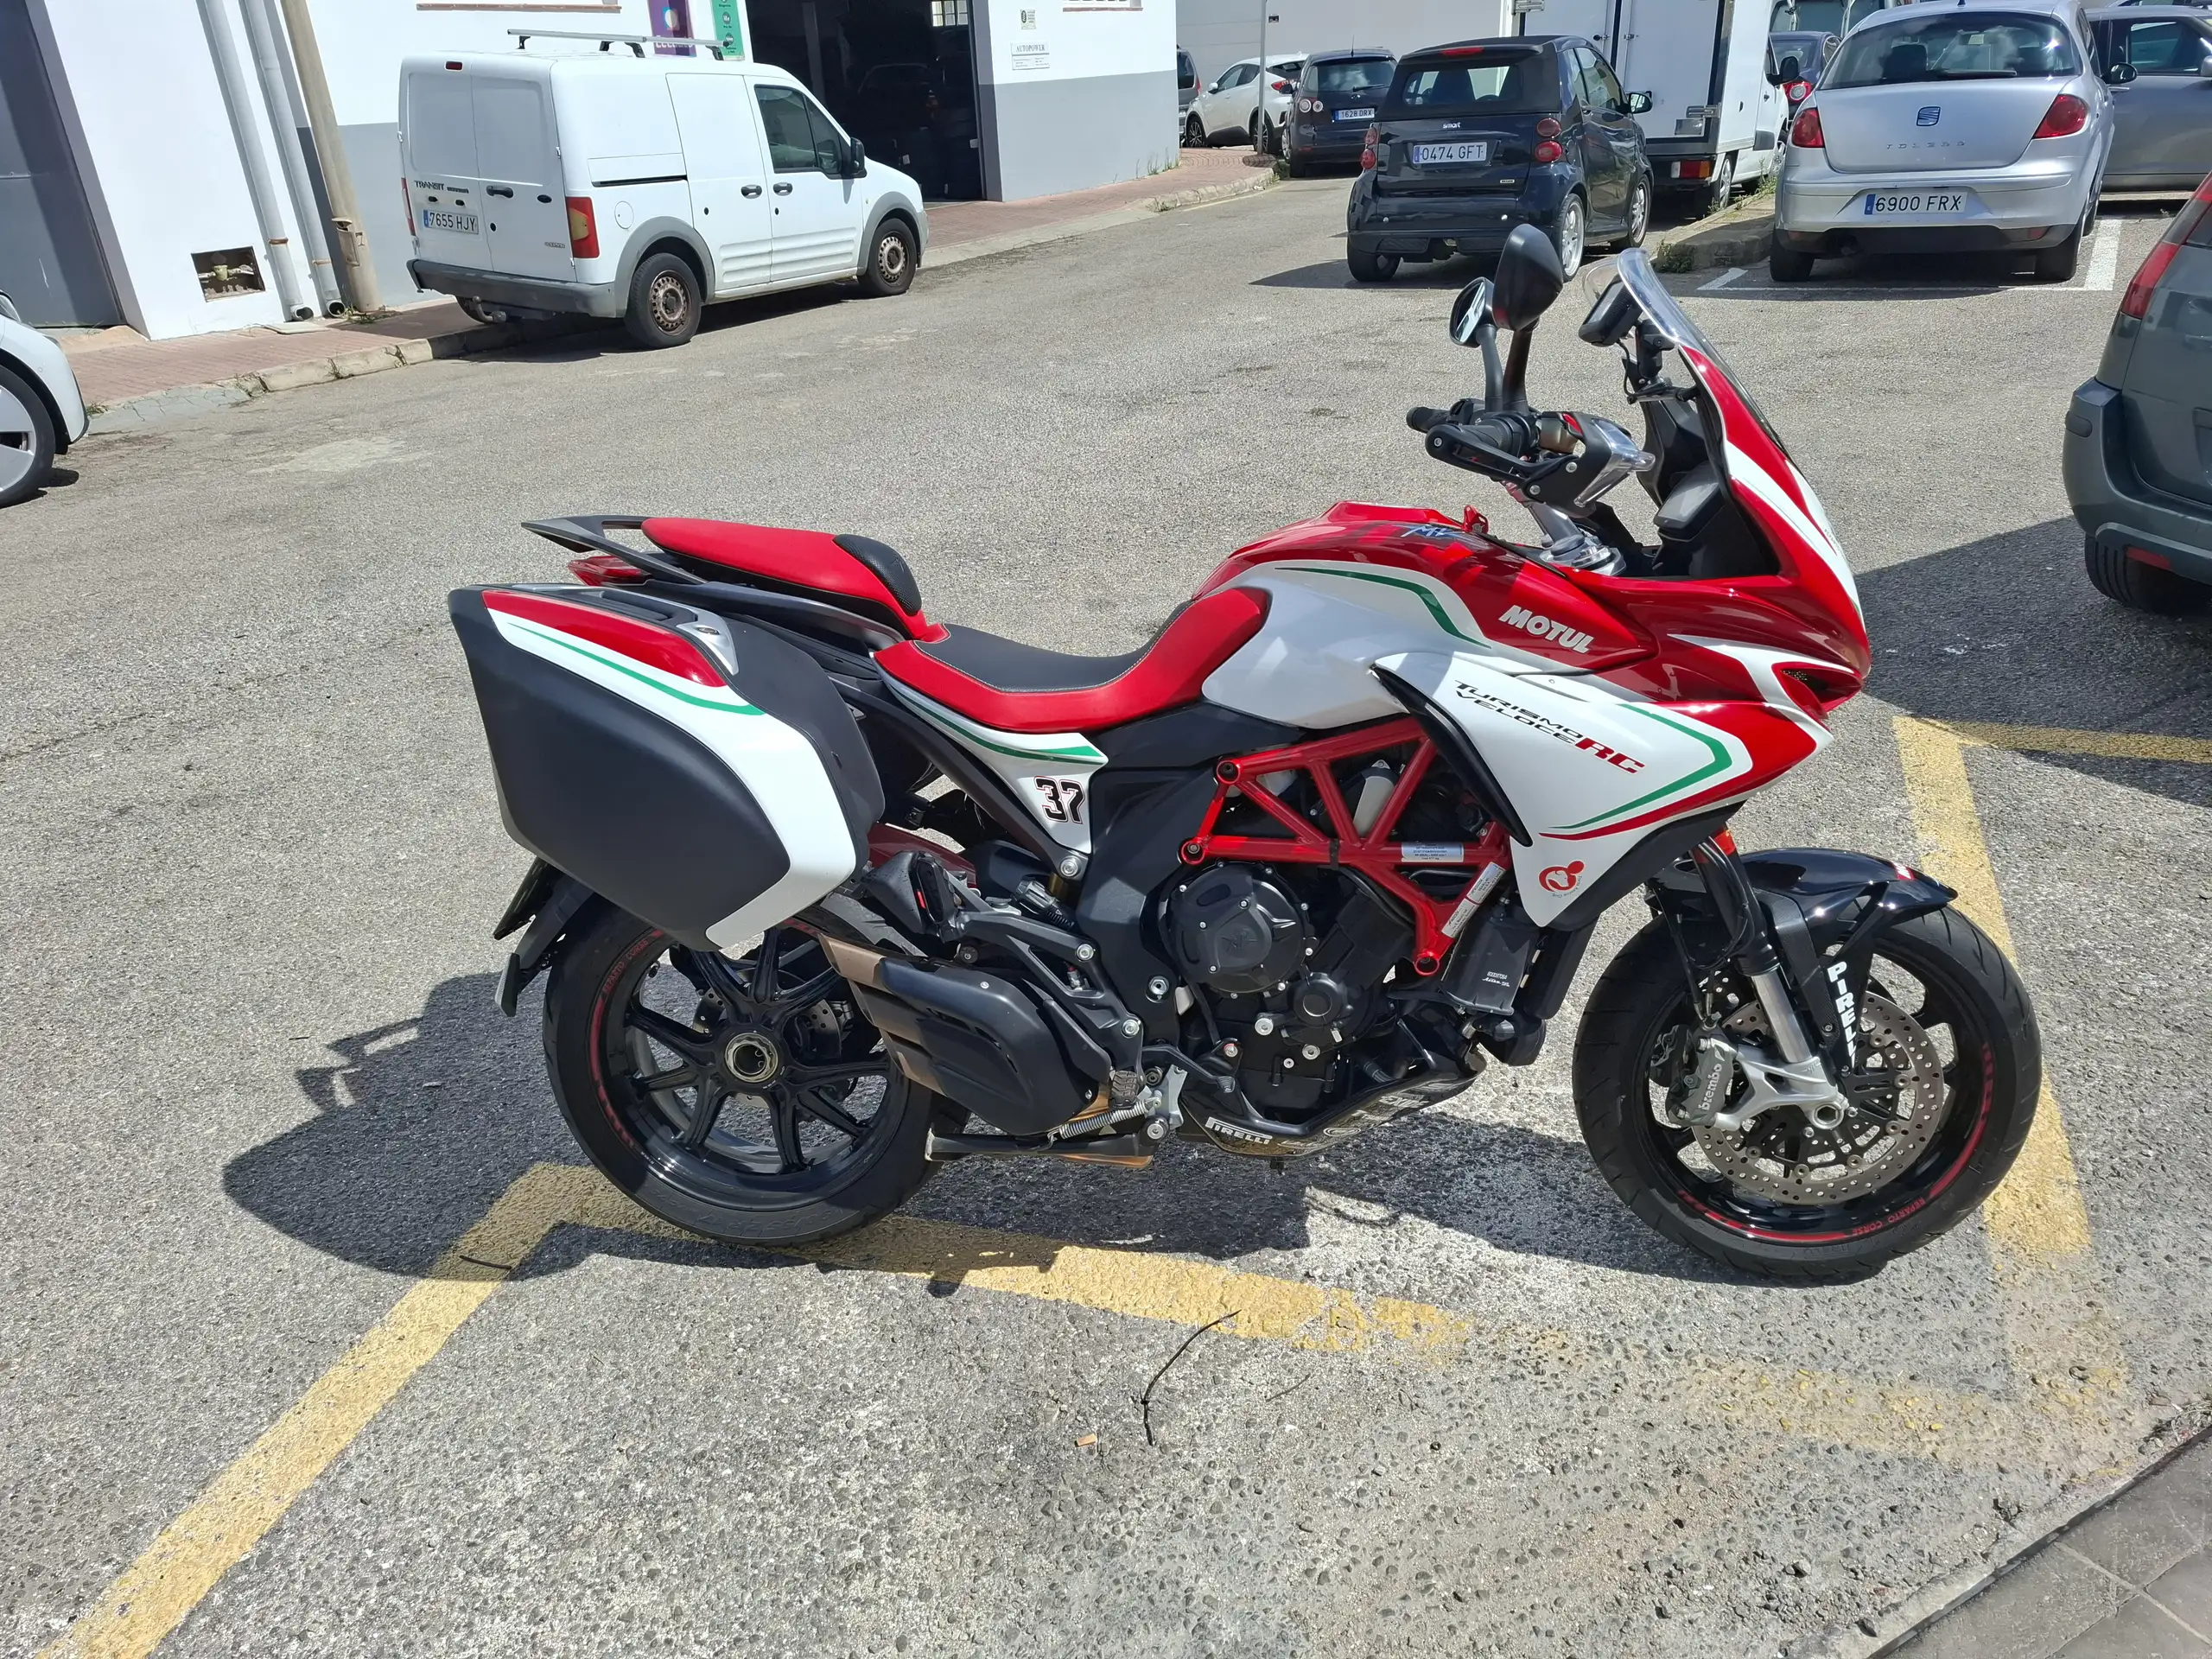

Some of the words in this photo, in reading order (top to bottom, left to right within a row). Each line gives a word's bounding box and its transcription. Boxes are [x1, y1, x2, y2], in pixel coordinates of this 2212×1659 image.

[1015, 44, 1046, 53] AUTOPOWER
[1341, 110, 1357, 118] 1628
[1421, 146, 1453, 160] 0474
[1458, 144, 1484, 159] GFT
[1886, 141, 1966, 149] TOLEDO
[414, 180, 445, 191] TRANSIT
[1875, 196, 1921, 212] 6900
[1926, 194, 1961, 211] FRX
[429, 212, 454, 228] 7655
[456, 215, 475, 232] HJY
[1497, 604, 1594, 654] MOTUL
[1454, 679, 1584, 740] TURISMO
[1455, 690, 1576, 744] VELOCE
[1574, 737, 1645, 774] RC
[1033, 775, 1085, 825] 37
[1827, 961, 1857, 1068] PIRELLI
[1698, 1063, 1723, 1110] brembo
[1205, 1116, 1274, 1145] PIRELLI
[1888, 1198, 1926, 1223] REPARTO
[1851, 1221, 1884, 1236] CORSE
